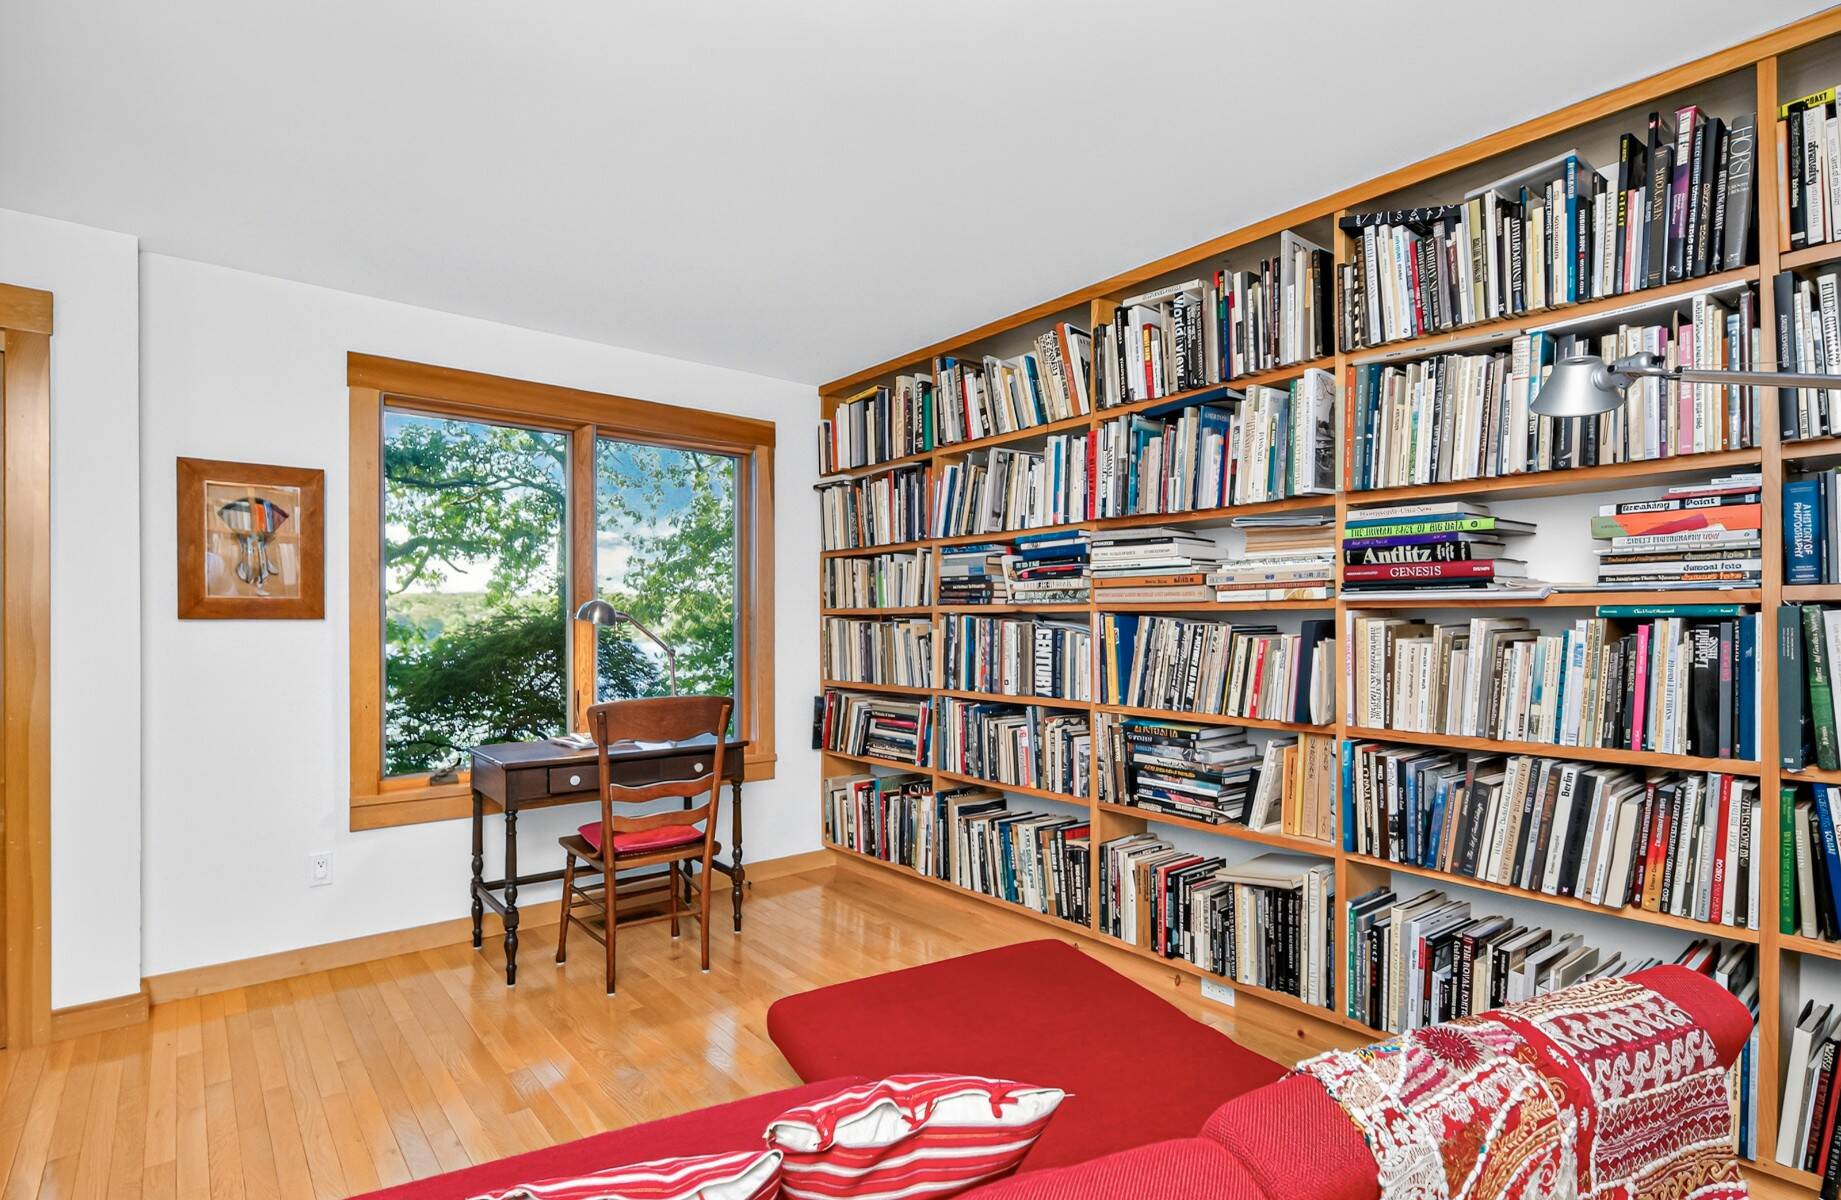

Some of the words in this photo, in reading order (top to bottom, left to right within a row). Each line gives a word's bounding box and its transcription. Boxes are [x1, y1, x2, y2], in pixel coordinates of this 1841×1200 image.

[1729, 126, 1753, 181] HORST
[1655, 168, 1665, 197] YORK
[1653, 197, 1662, 221] NEW
[1362, 545, 1432, 564] Antlitz
[1390, 565, 1441, 577] GENESIS
[1035, 629, 1053, 697] CENTURY
[1561, 772, 1574, 797] Berlin
[1463, 944, 1473, 961] THE
[1462, 963, 1472, 989] ROYAL
